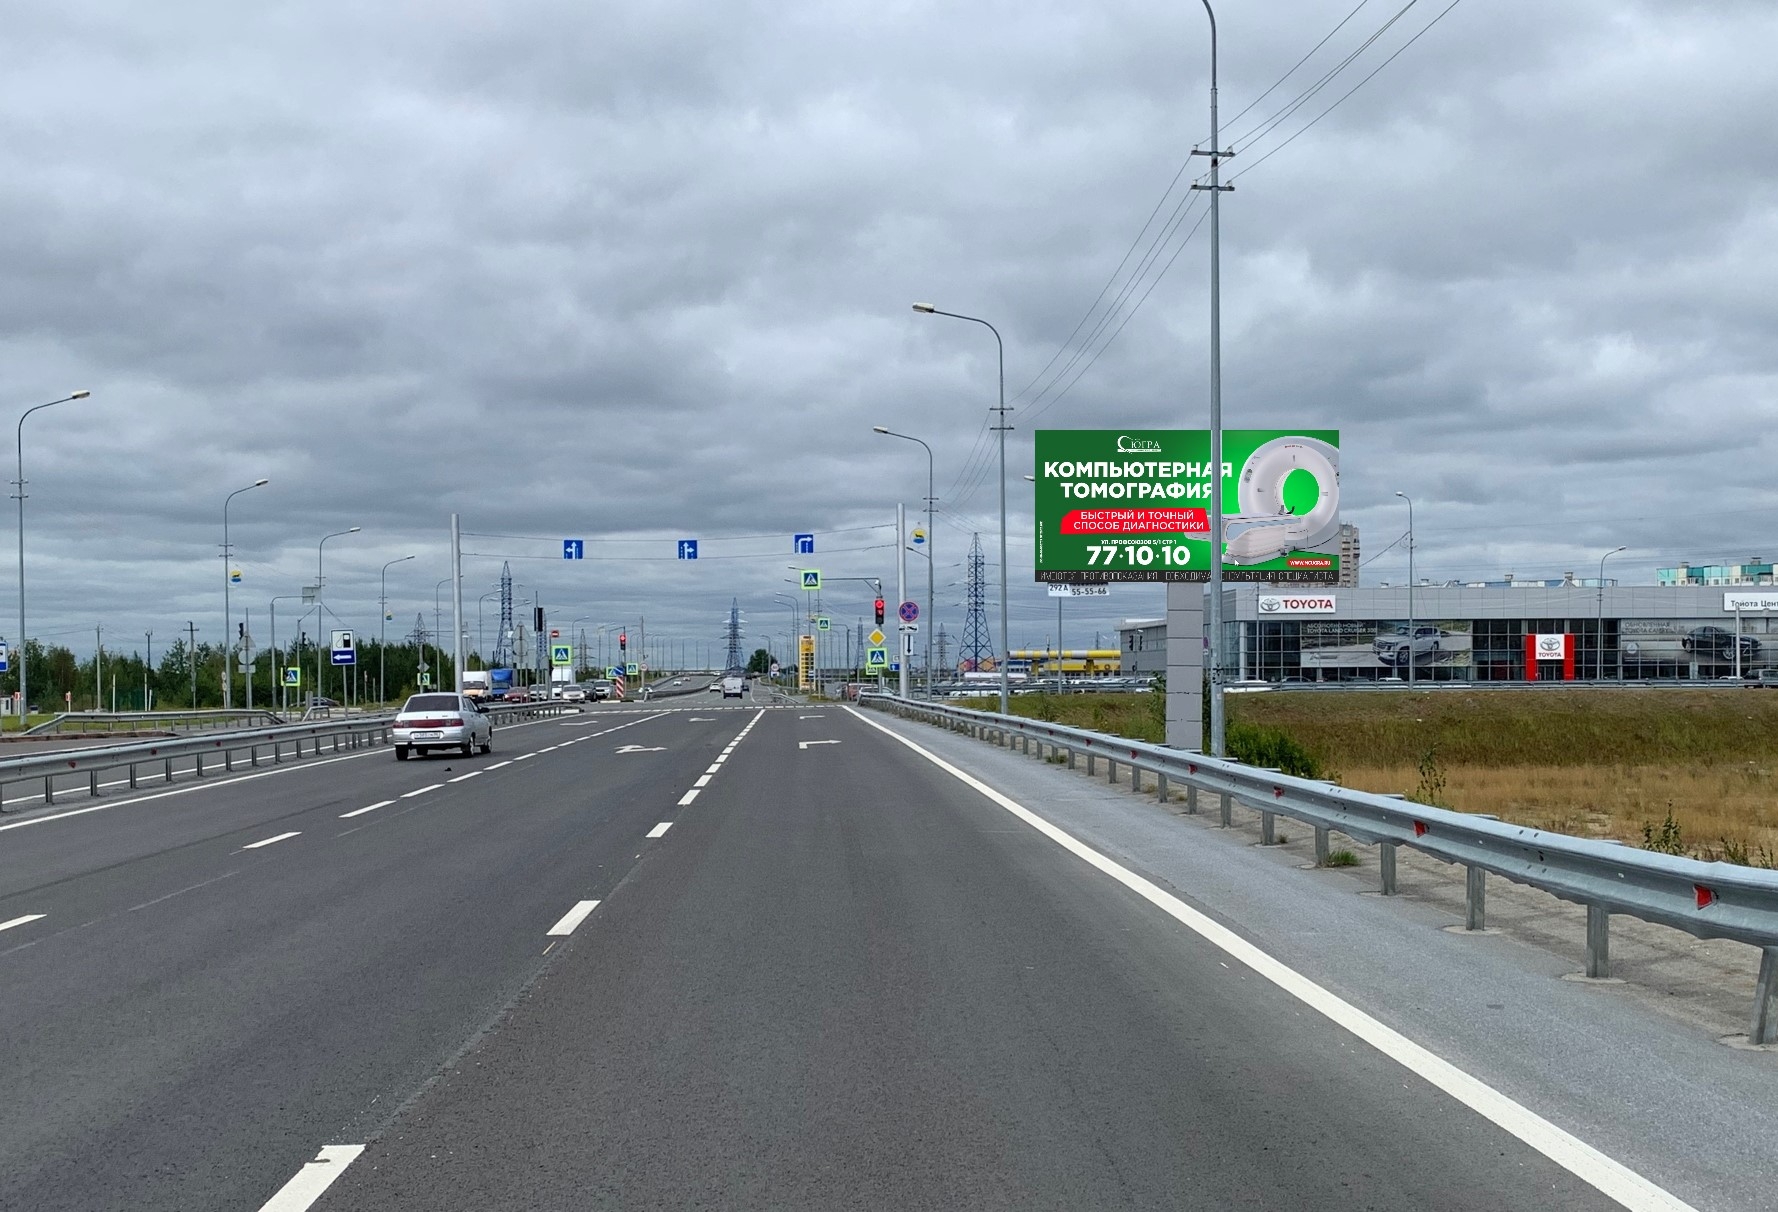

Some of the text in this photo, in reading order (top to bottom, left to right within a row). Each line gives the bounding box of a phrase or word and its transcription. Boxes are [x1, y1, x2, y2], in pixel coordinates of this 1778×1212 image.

[1044, 461, 1232, 478] КОМПЬЮТЕРНАЯ
[1060, 482, 1212, 499] ТОМОГРАФИЯ
[1080, 509, 1194, 520] БЫСТРЫЙ И ТОЧНЫЙ
[1073, 521, 1205, 532] СПОСОБ ДИАГНОСТИКИ
[1071, 587, 1107, 596] 55-55-66
[1283, 599, 1333, 609] TOYOTA
